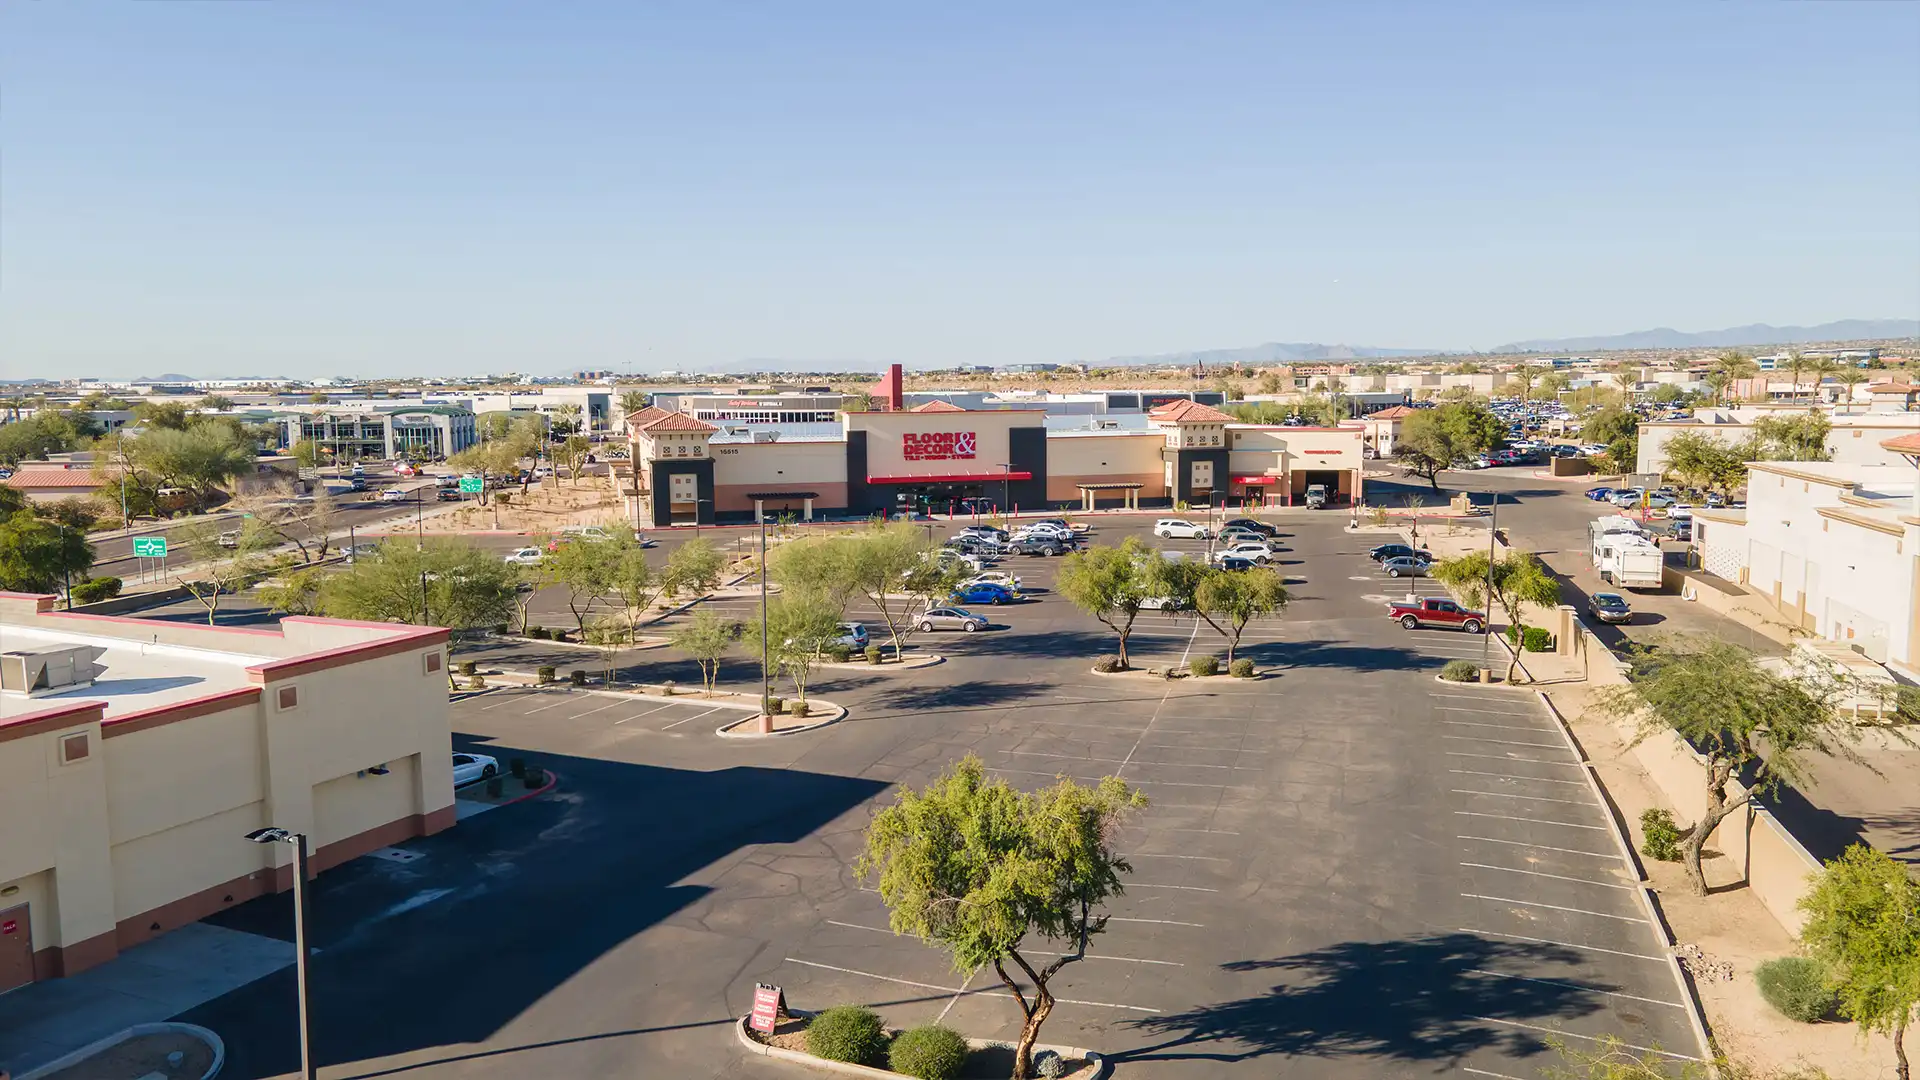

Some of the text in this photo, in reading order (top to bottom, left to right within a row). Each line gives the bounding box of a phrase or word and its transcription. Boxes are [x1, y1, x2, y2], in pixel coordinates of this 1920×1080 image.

[903, 432, 976, 454] FLOOR &
[903, 444, 954, 455] DECOR
